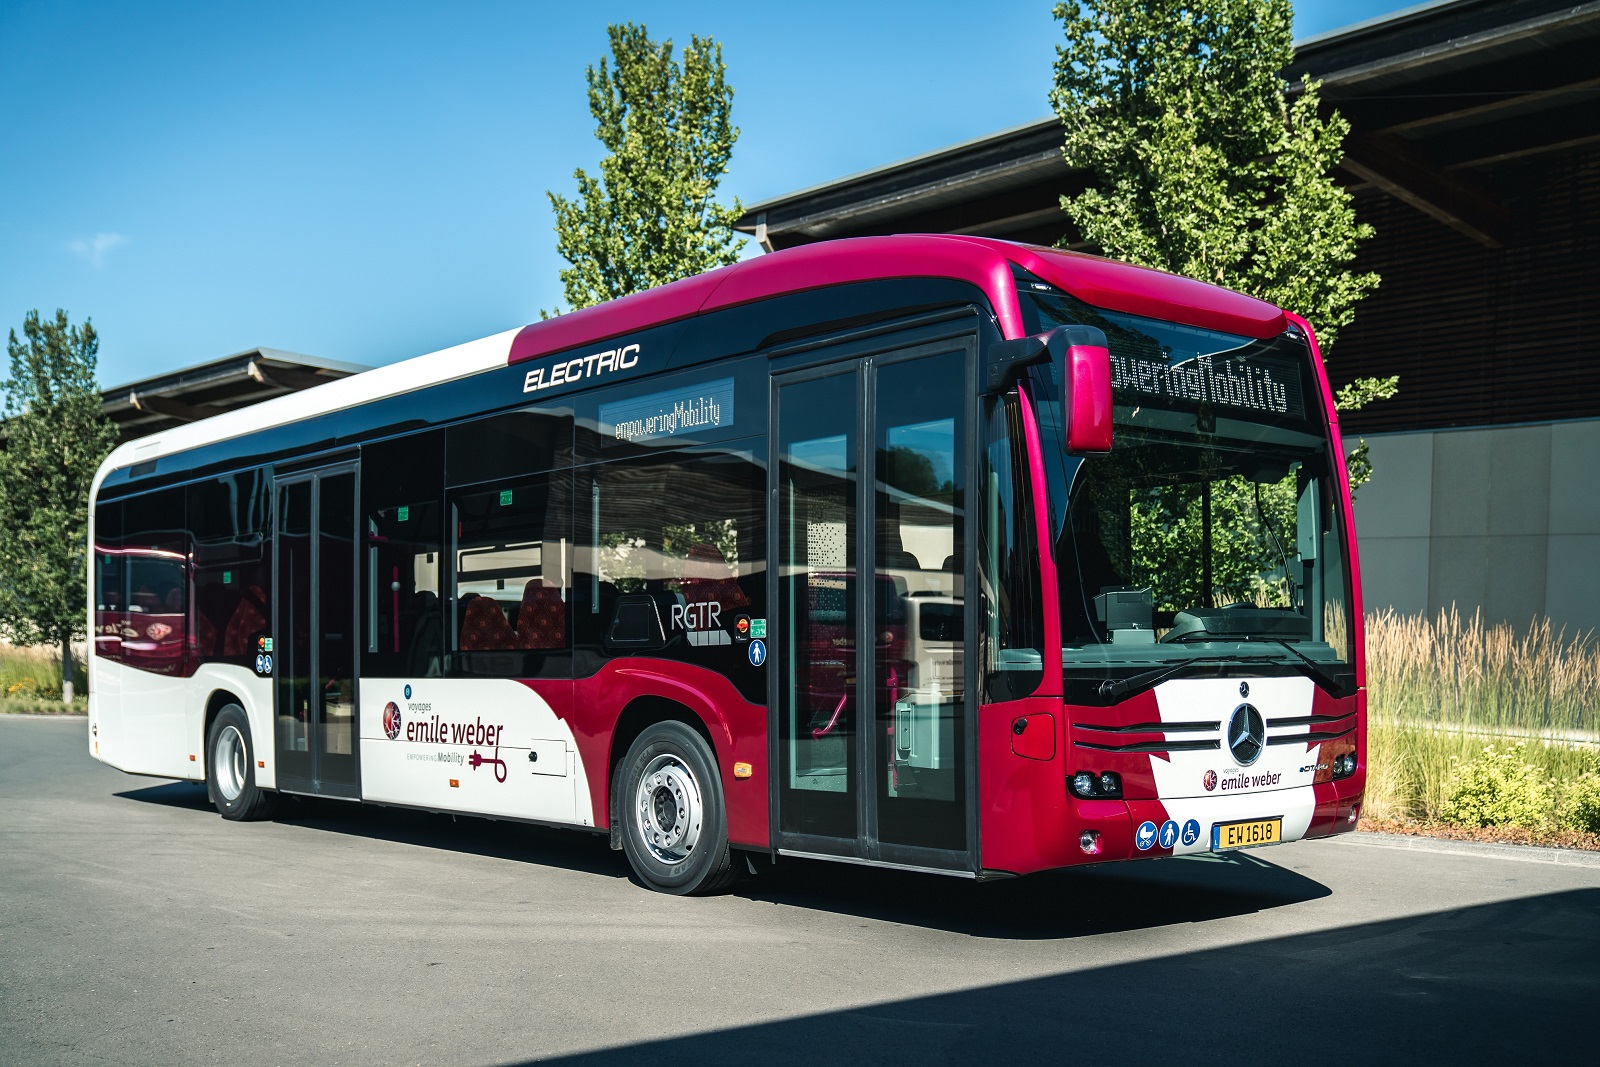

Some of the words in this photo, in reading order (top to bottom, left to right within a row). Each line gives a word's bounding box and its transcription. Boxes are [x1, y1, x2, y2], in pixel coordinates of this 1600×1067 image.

[523, 343, 641, 393] ELECTRIC
[1109, 351, 1288, 413] oweringMobility
[615, 397, 720, 441] empoweringMobility
[671, 601, 722, 630] RGTR
[407, 702, 432, 714] voyages
[406, 714, 448, 743] emile
[451, 716, 503, 746] weber
[1221, 772, 1250, 790] emile
[1251, 770, 1282, 788] weber
